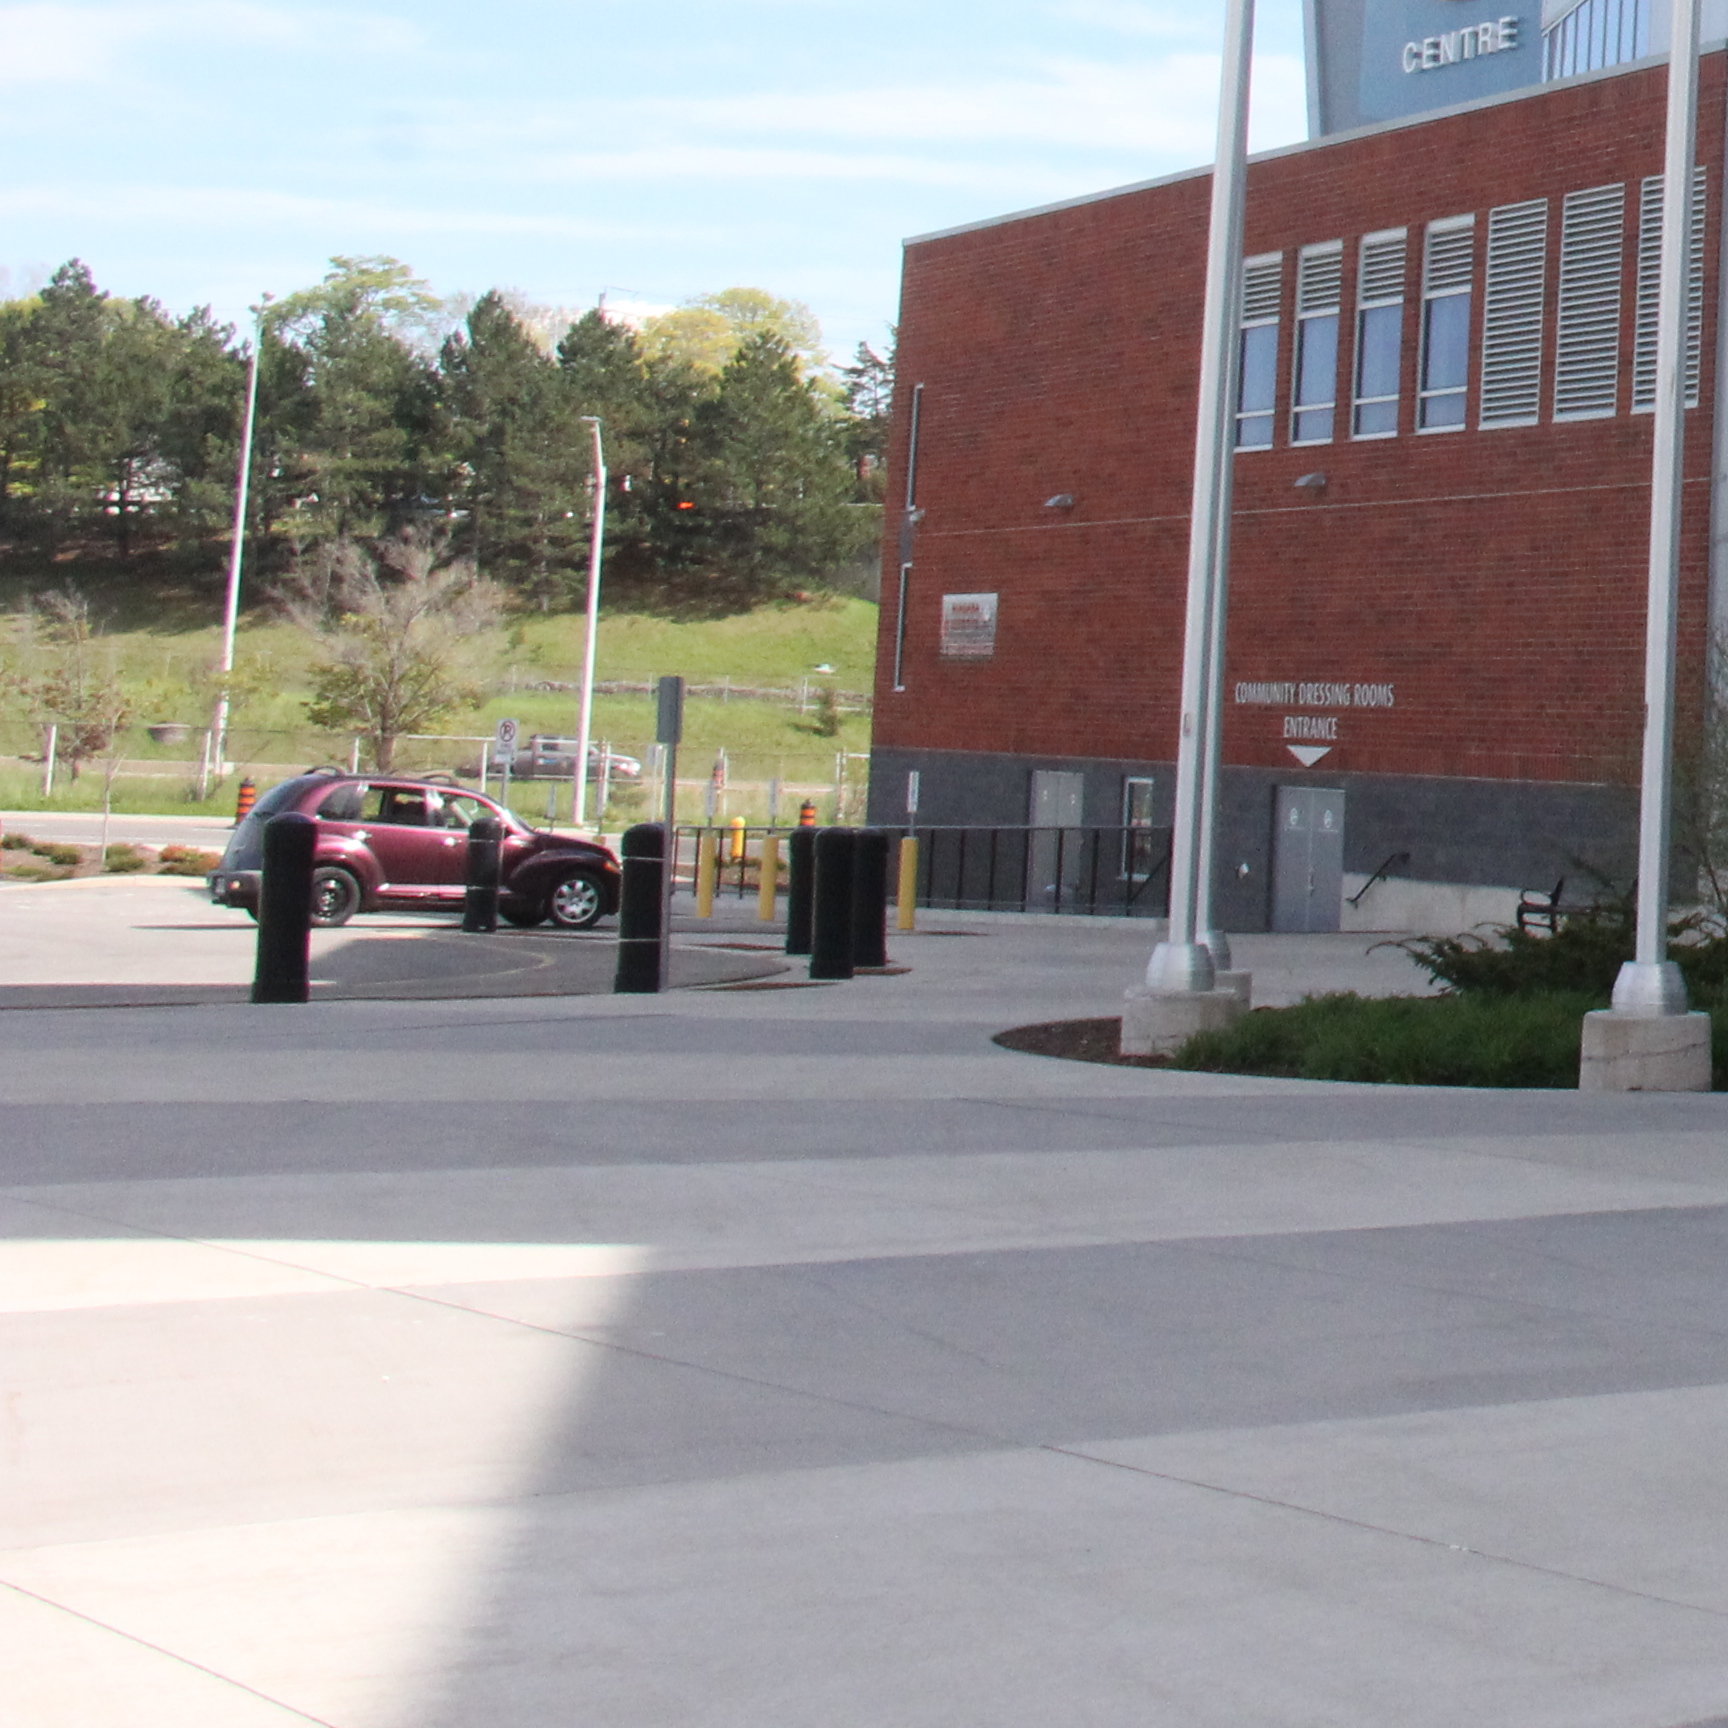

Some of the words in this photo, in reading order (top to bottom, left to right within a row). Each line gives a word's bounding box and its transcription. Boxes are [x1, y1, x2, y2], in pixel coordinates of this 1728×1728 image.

[1403, 16, 1519, 73] CENTRE
[1235, 682, 1296, 704] COMMUNITY
[1299, 682, 1350, 706] DRESSING
[1354, 684, 1394, 707] ROOMS
[1283, 716, 1338, 740] ENTRANCE
